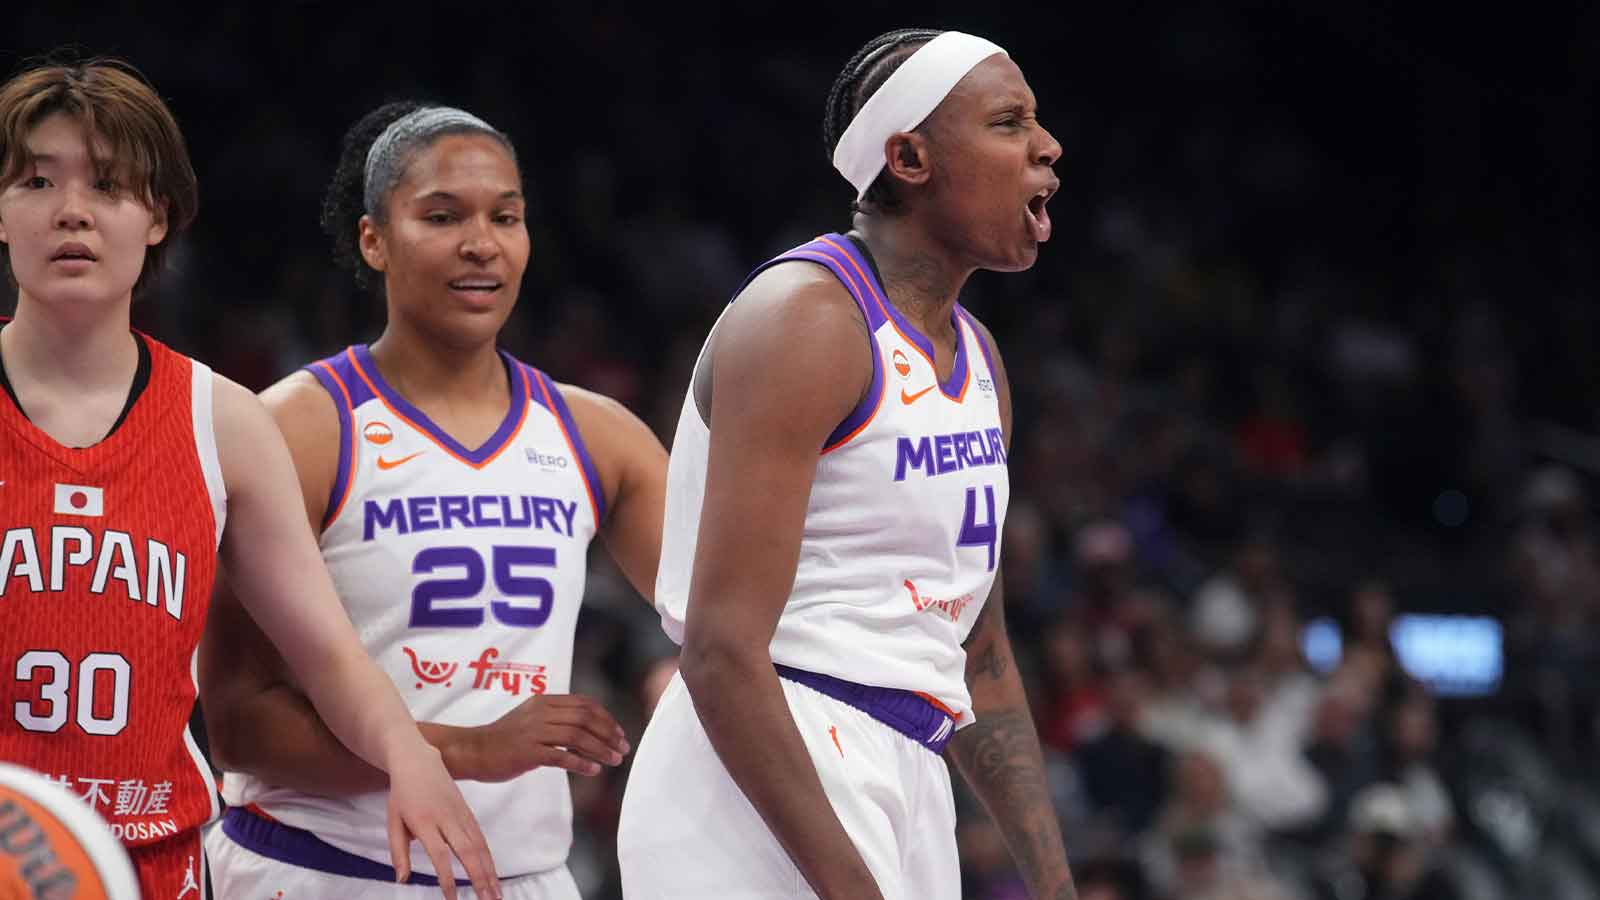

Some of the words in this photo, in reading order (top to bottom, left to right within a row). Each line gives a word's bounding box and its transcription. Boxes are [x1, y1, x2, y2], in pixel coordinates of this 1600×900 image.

[894, 427, 1007, 481] MERCUR
[363, 495, 577, 542] MERCURY
[956, 485, 997, 572] 4
[0, 525, 186, 621] APAN
[408, 545, 557, 629] 25
[14, 650, 131, 736] 30
[468, 647, 547, 696] fry's
[107, 819, 178, 841] DOSAN
